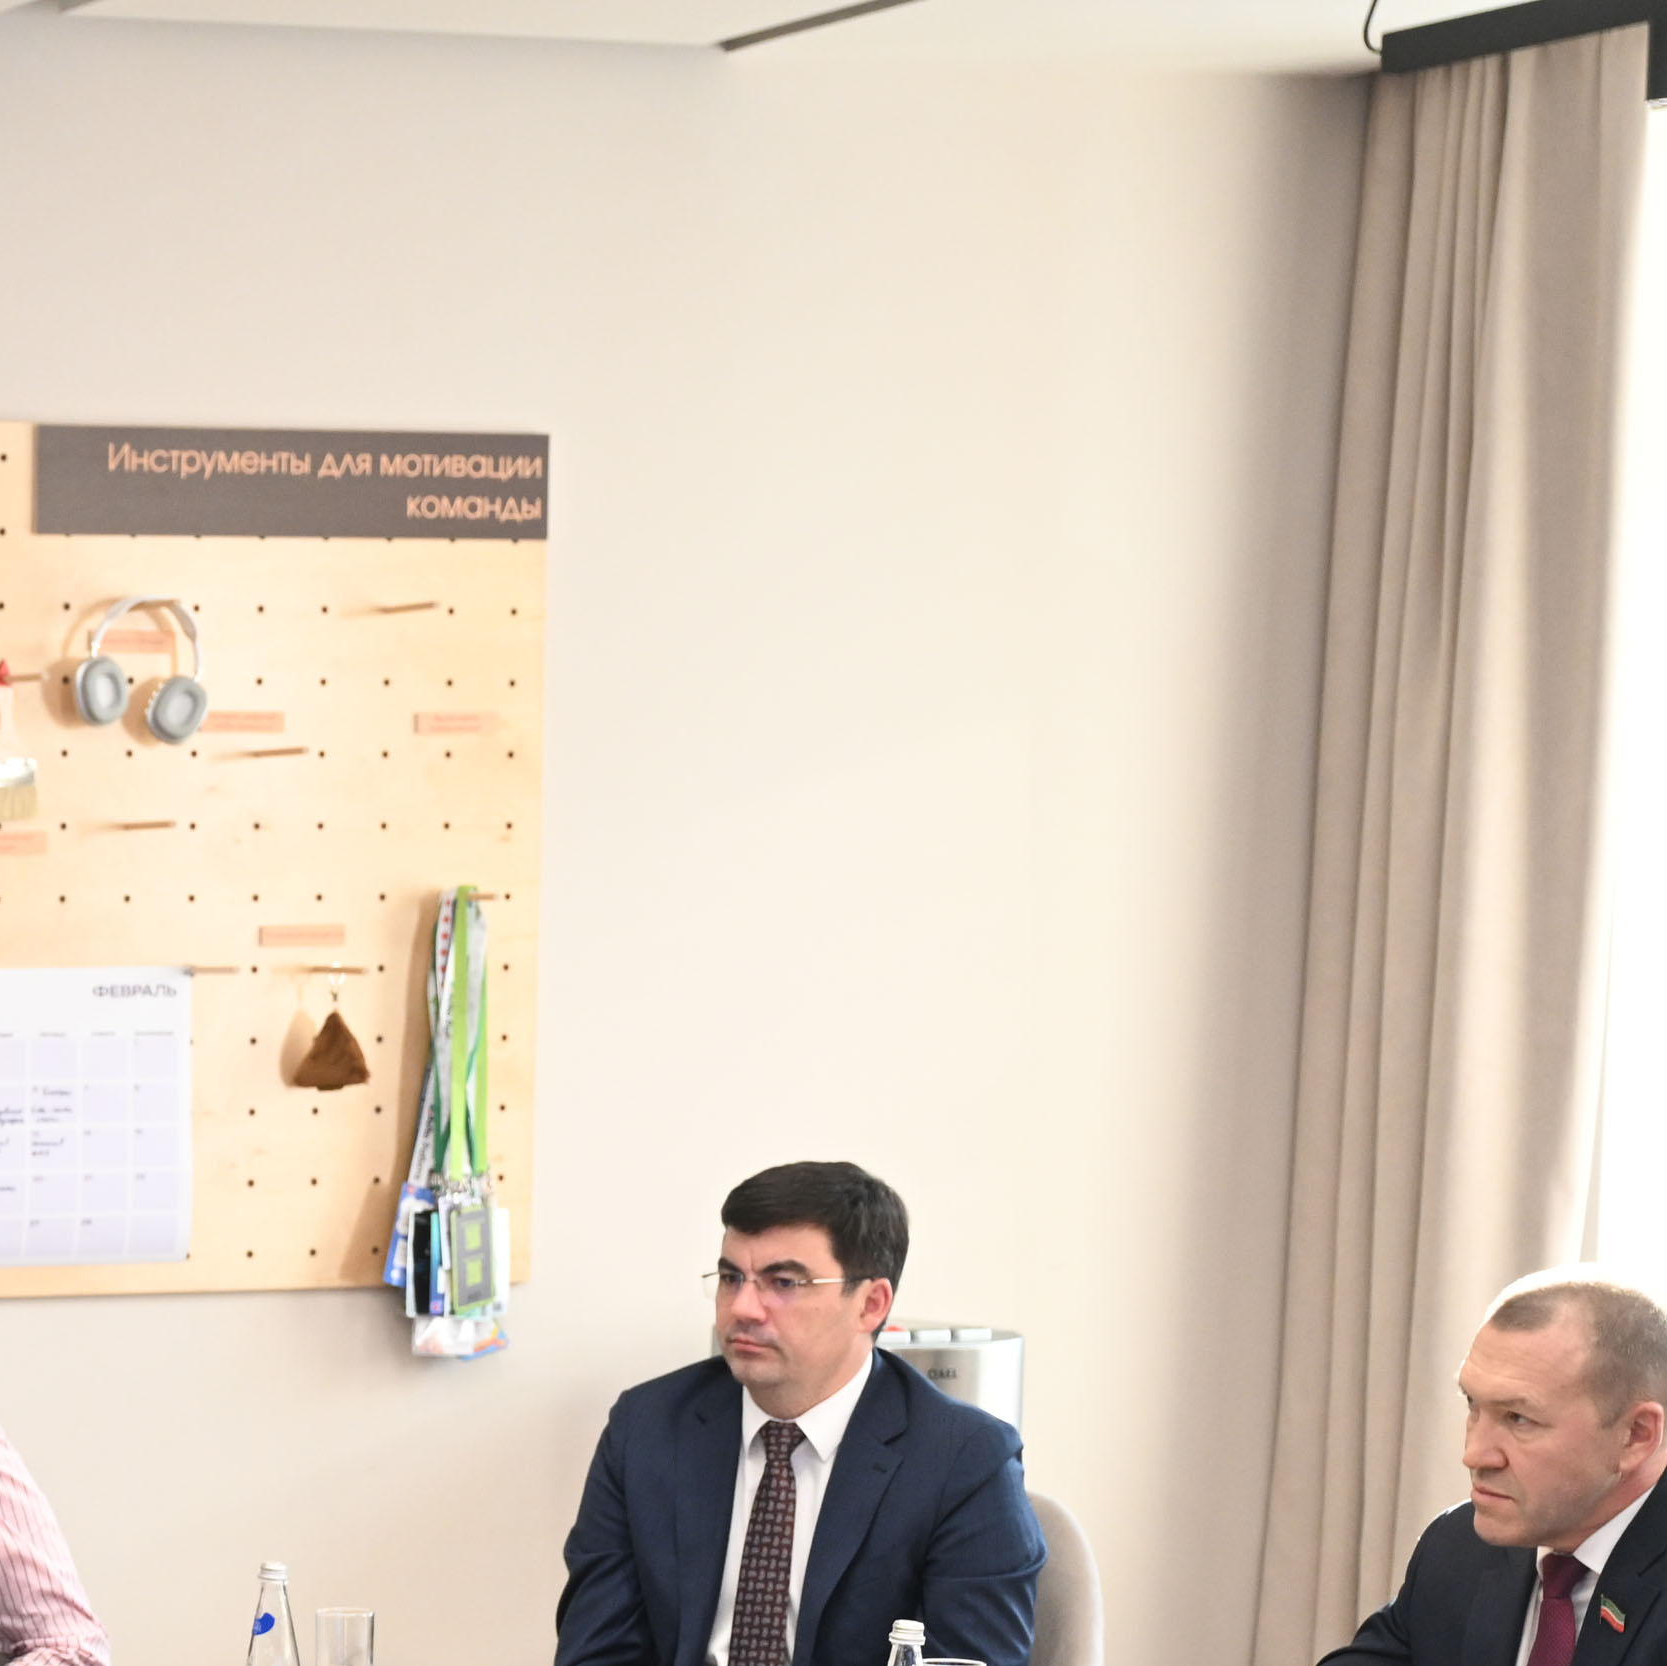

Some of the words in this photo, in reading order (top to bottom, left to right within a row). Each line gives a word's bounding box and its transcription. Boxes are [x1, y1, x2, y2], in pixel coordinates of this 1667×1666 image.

[107, 442, 312, 480] Инструменты
[317, 452, 373, 478] для
[379, 453, 543, 481] мотивации
[406, 495, 543, 521] команды
[92, 984, 177, 998] ФЕВРАЛЬ
